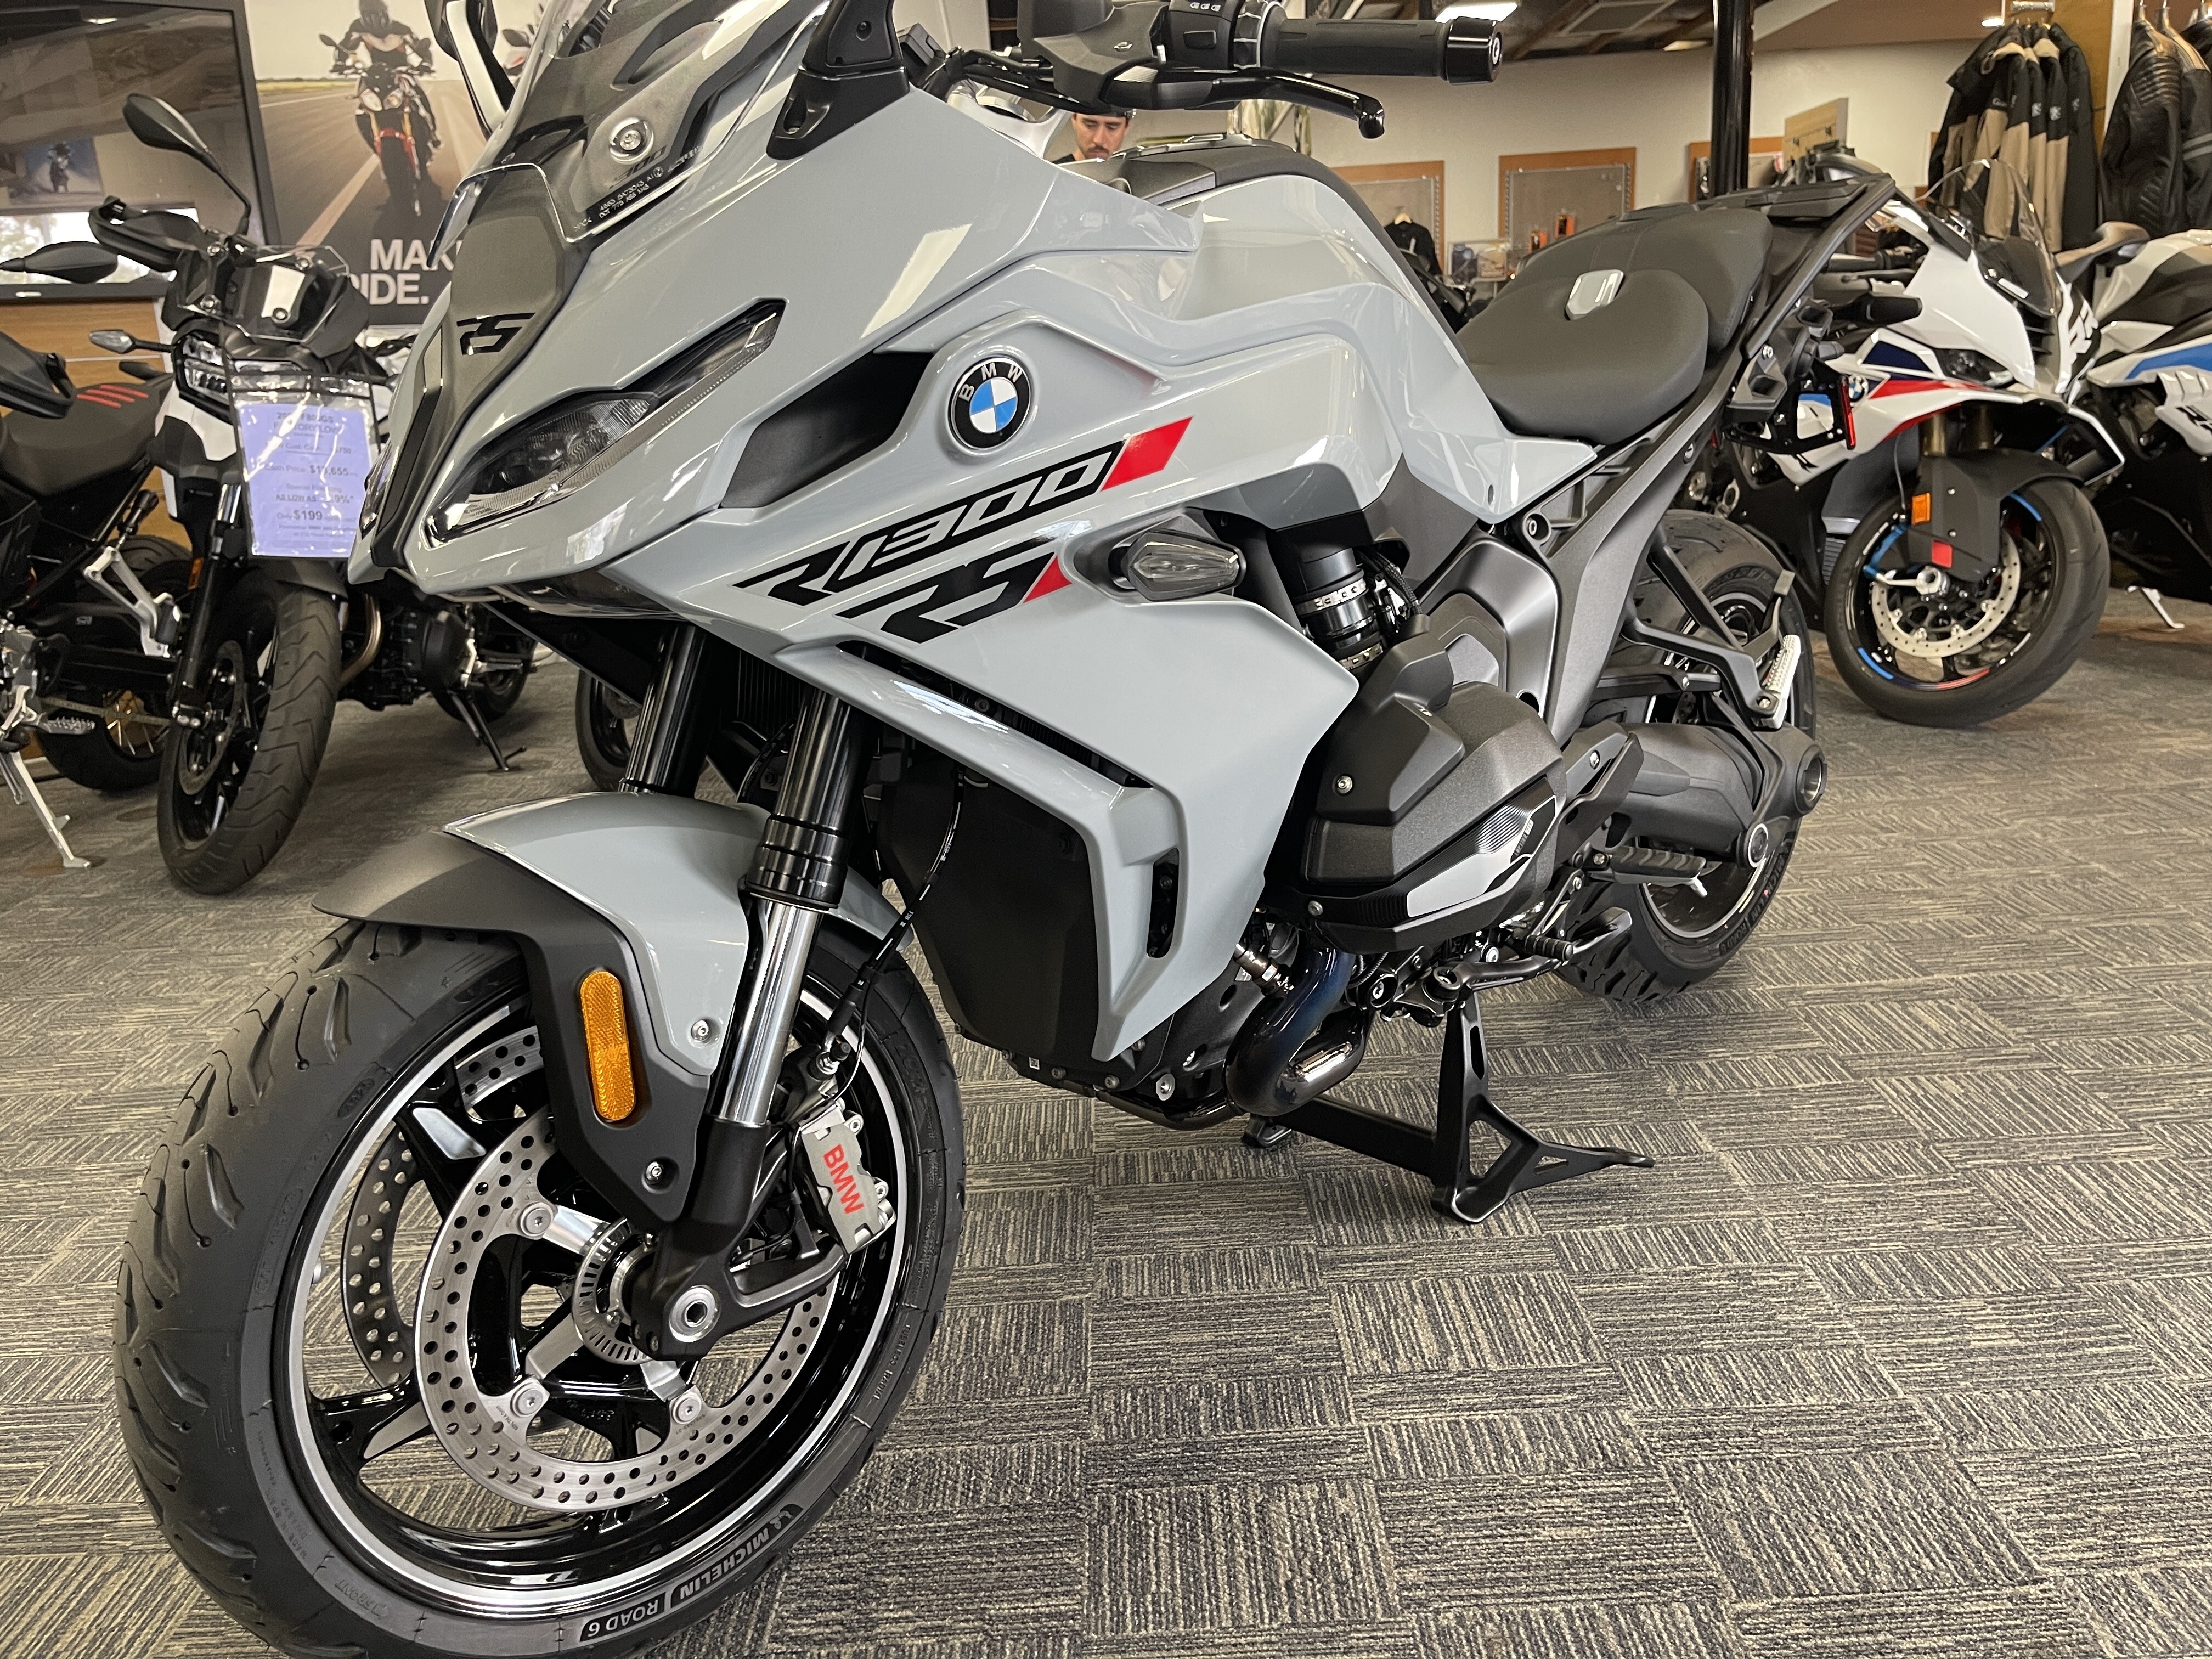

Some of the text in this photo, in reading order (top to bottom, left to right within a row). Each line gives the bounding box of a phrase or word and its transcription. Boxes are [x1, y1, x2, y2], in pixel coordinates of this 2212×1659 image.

[370, 239, 462, 271] MAK
[349, 273, 430, 305] IDE.
[958, 362, 1023, 402] BMW
[294, 510, 323, 520] $199
[823, 1144, 865, 1214] BMW
[588, 1528, 770, 1637] MICHELIN ROAD 6
